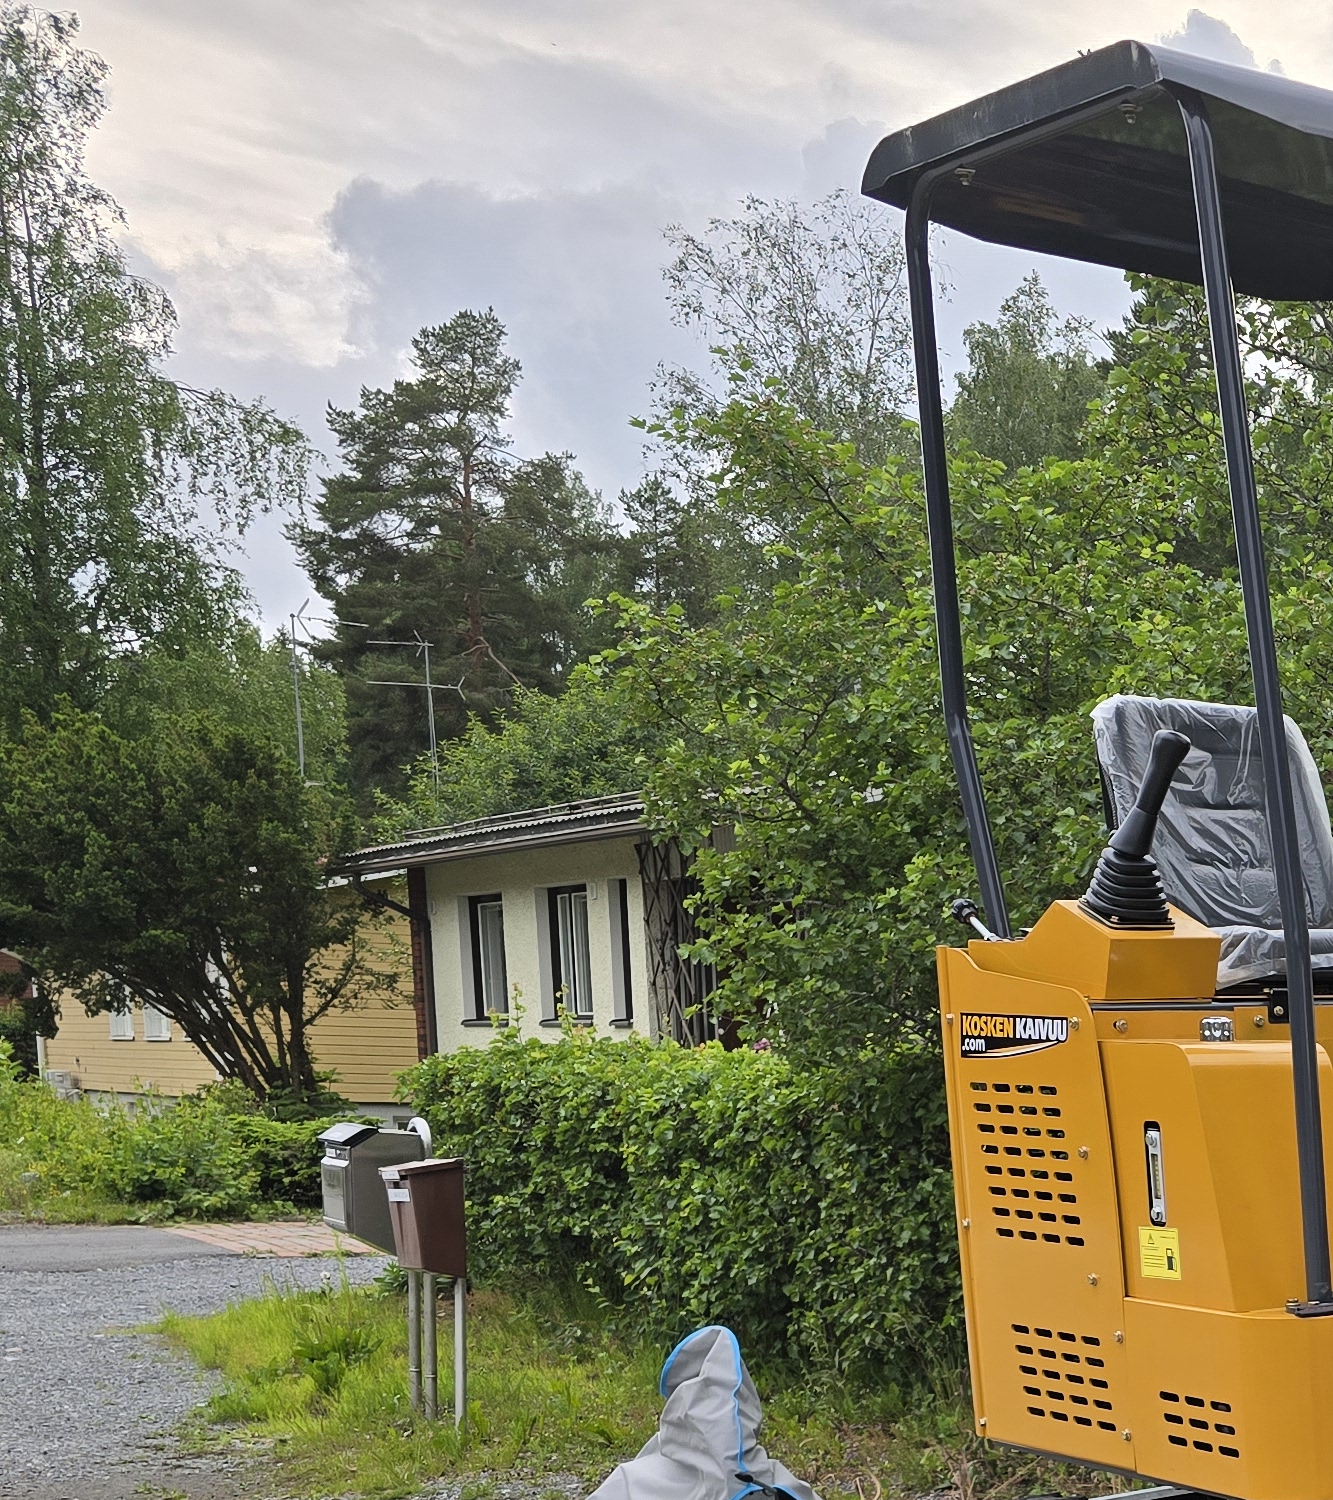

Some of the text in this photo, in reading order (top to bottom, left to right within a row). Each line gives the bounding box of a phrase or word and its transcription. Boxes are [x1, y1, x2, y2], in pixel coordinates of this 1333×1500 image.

[962, 1015, 1067, 1041] KOSKEN KAIVUU
[962, 1038, 986, 1052] .com
